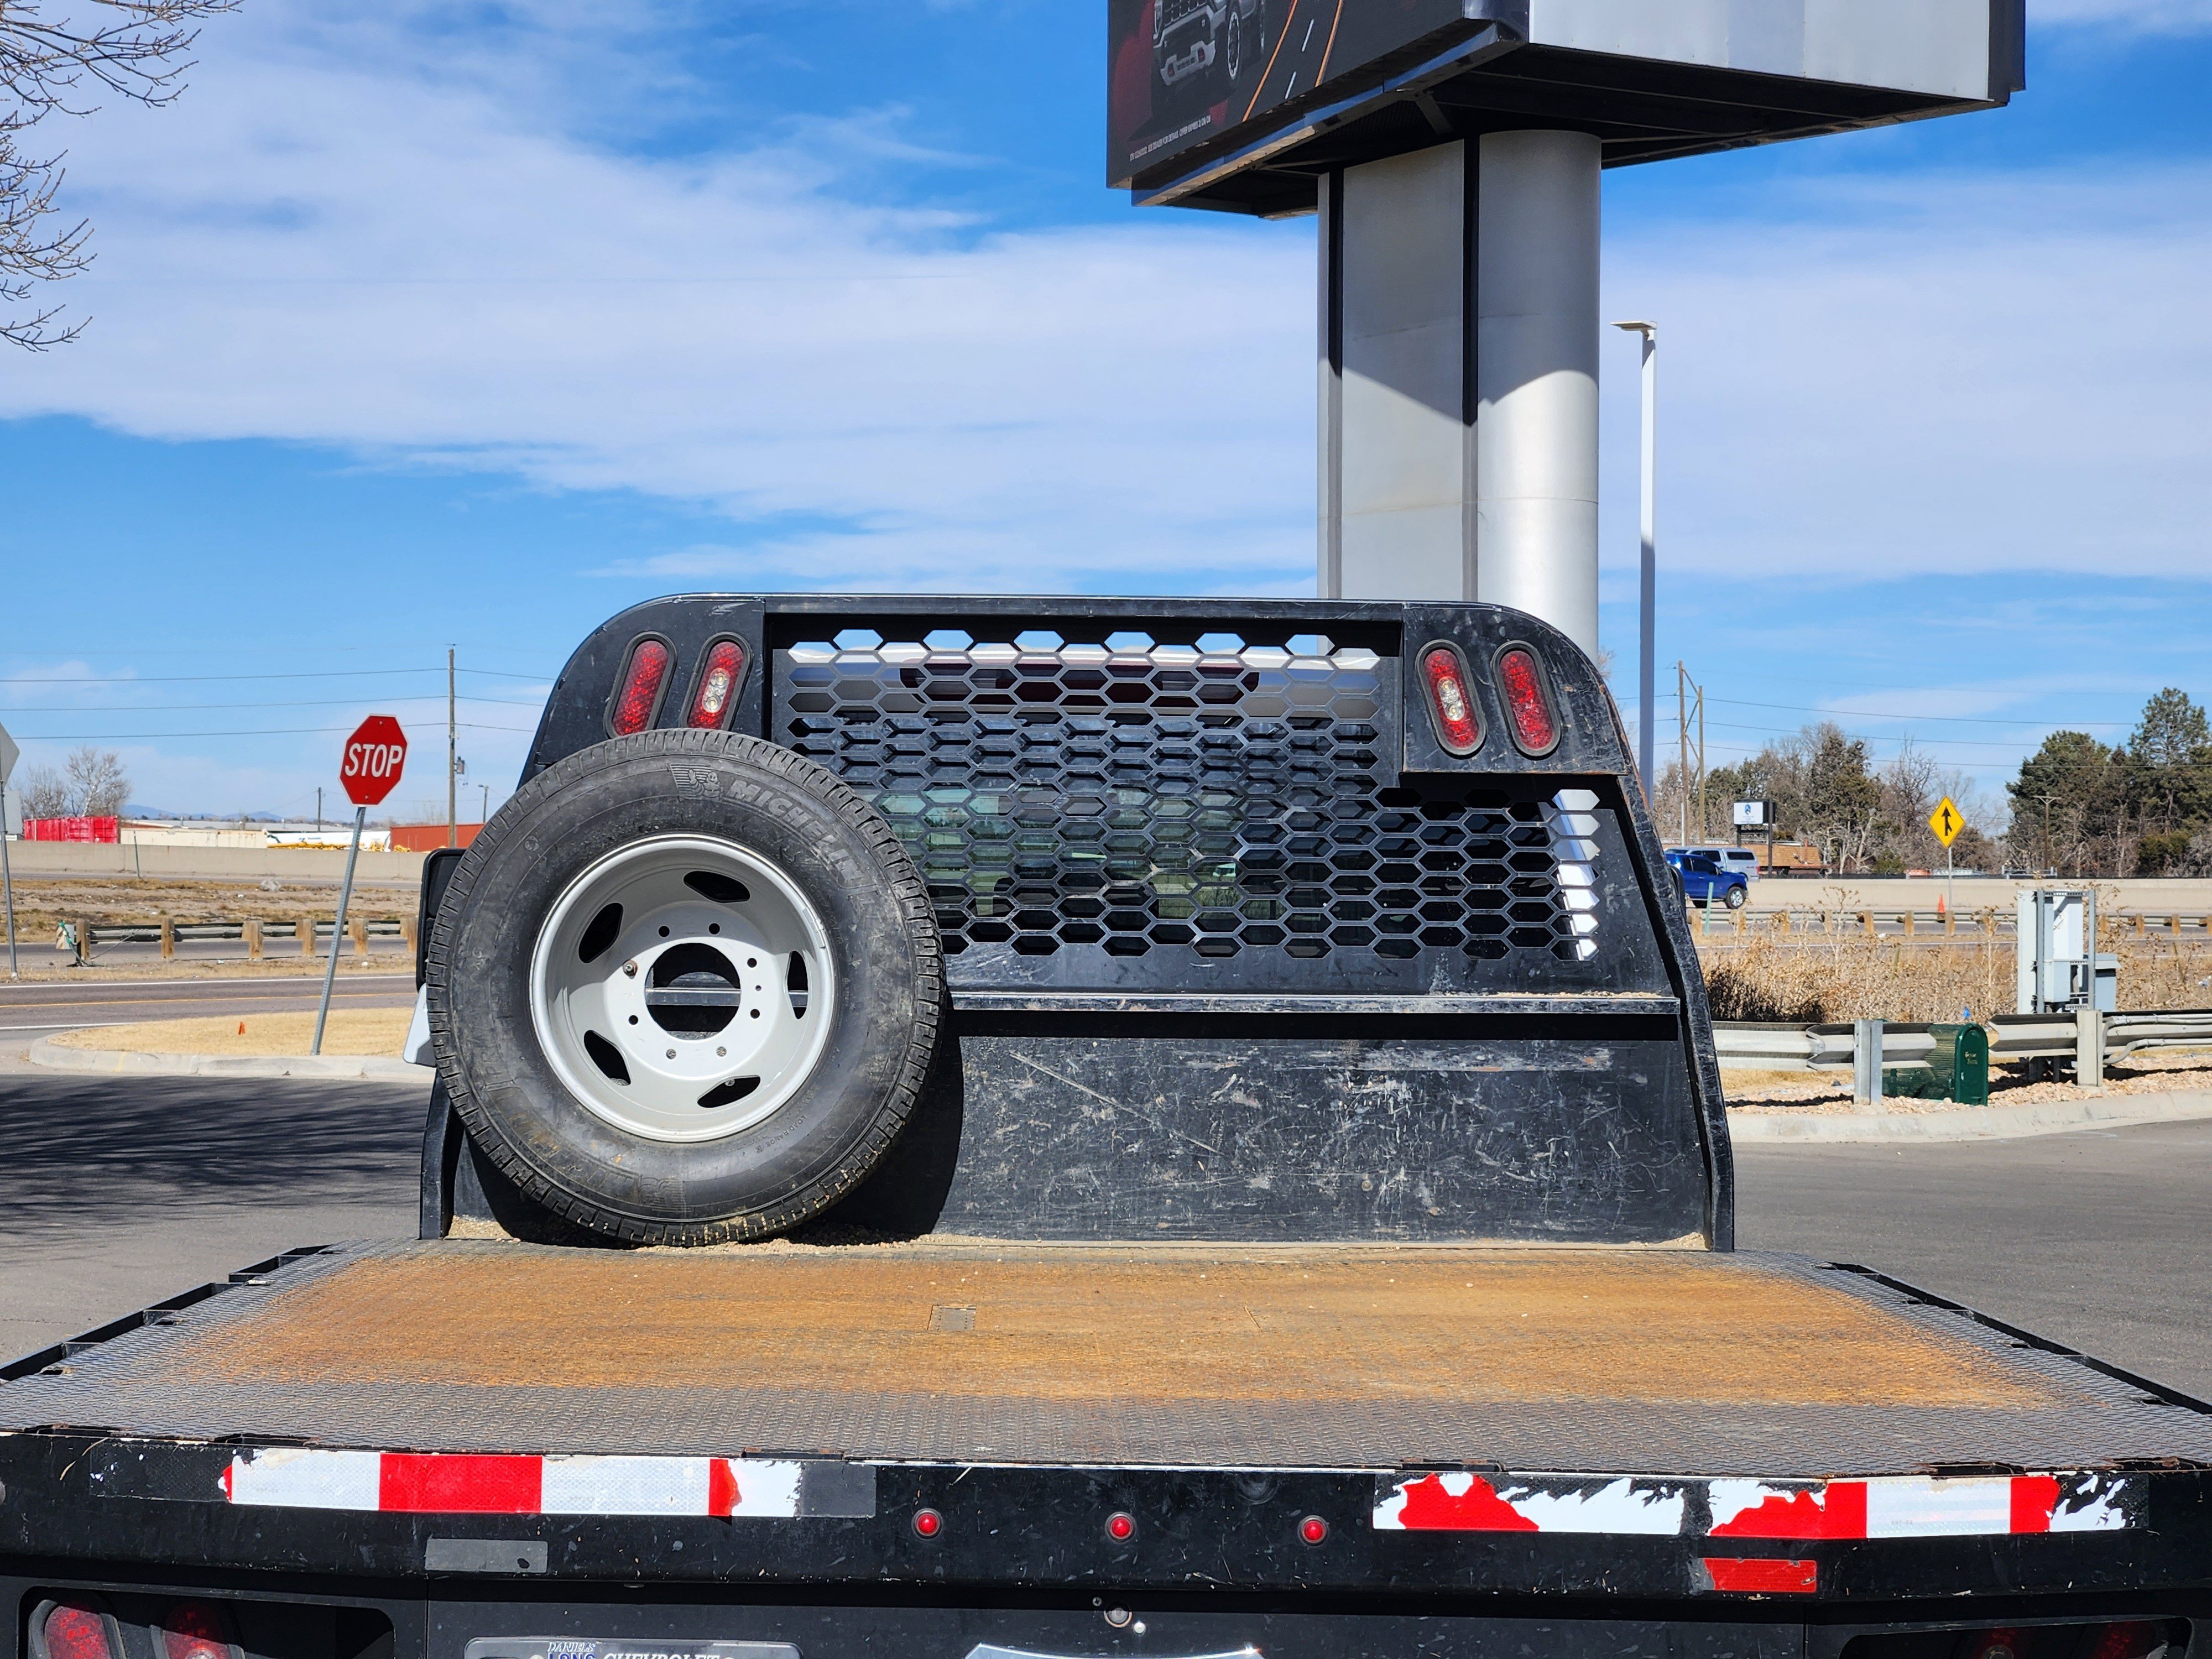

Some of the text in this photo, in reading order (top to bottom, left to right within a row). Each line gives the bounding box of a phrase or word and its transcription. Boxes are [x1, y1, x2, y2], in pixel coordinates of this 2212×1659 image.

[345, 743, 403, 778] STOP
[727, 779, 863, 880] MICHELIN
[789, 1115, 807, 1131] LOAD
[765, 1129, 789, 1147] RANGE
[547, 1642, 596, 1652] DANIELS
